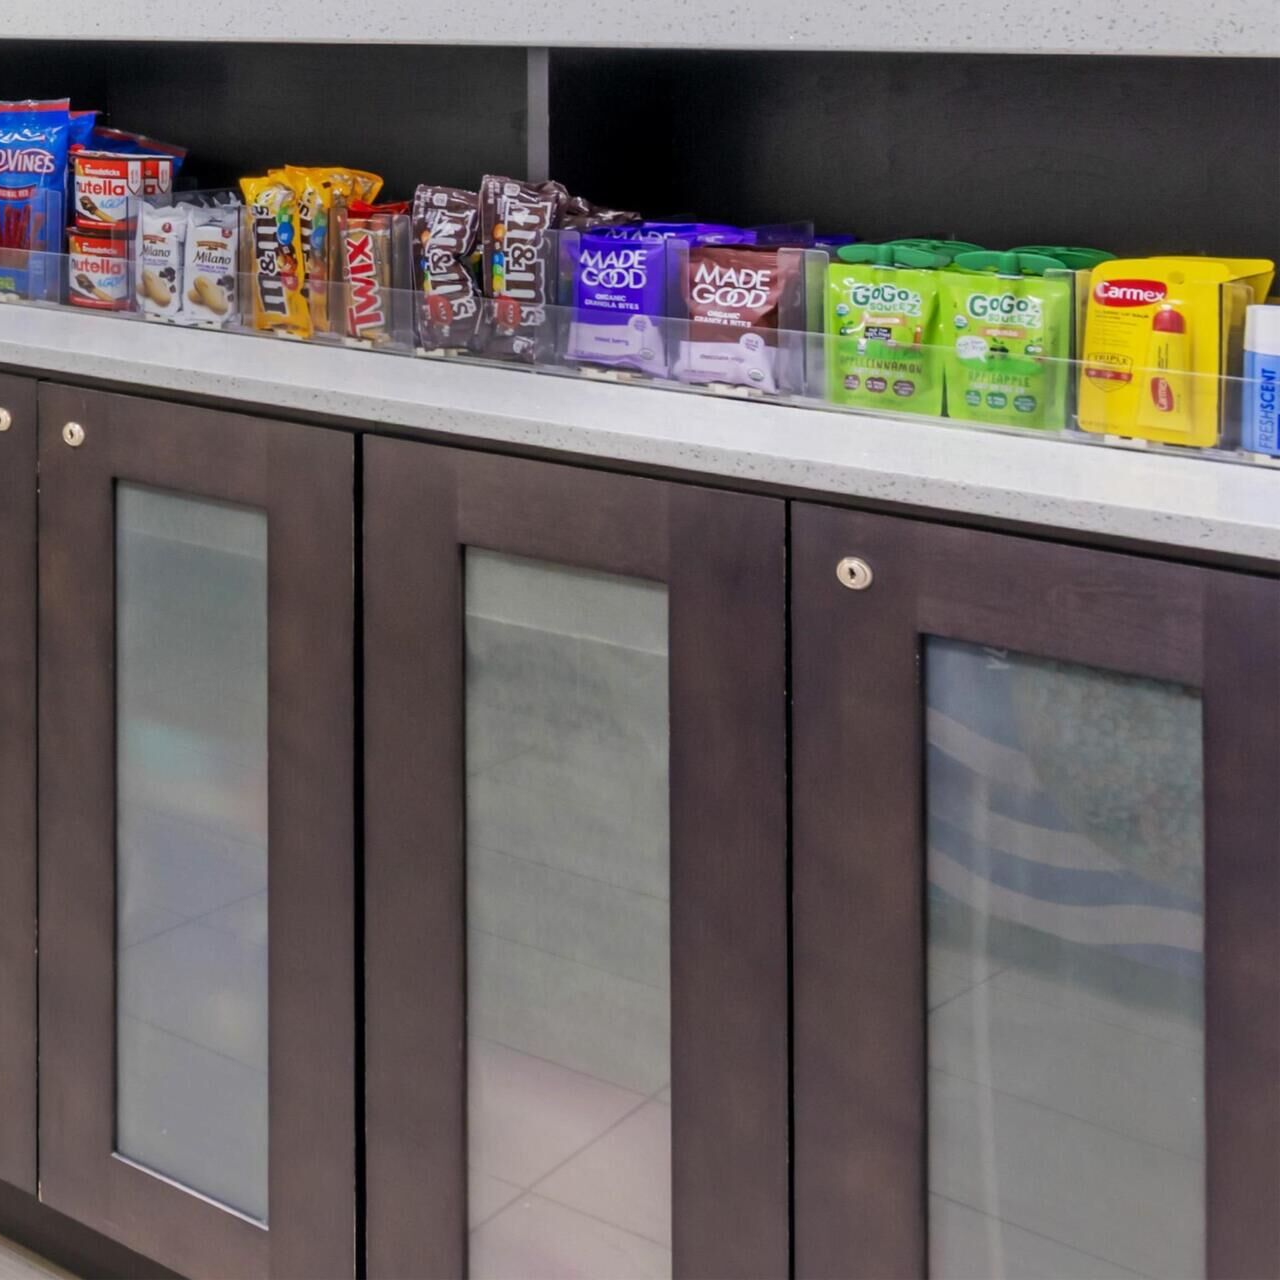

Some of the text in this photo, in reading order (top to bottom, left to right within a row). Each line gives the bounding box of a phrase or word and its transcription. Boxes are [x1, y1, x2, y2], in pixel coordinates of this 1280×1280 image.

[7, 150, 56, 173] VINES
[76, 179, 126, 196] nutella
[140, 243, 171, 258] Milano
[192, 250, 232, 266] Milano
[580, 250, 648, 270] MADE
[71, 258, 122, 275] nutella
[345, 235, 384, 337] TWIX
[581, 268, 647, 289] GOOD
[694, 264, 771, 291] MADE
[595, 293, 627, 302] ORGANIC
[692, 284, 768, 309] GOOD
[852, 283, 909, 306] GoGo
[1096, 281, 1165, 302] Carmex
[969, 295, 1028, 317] GoGo
